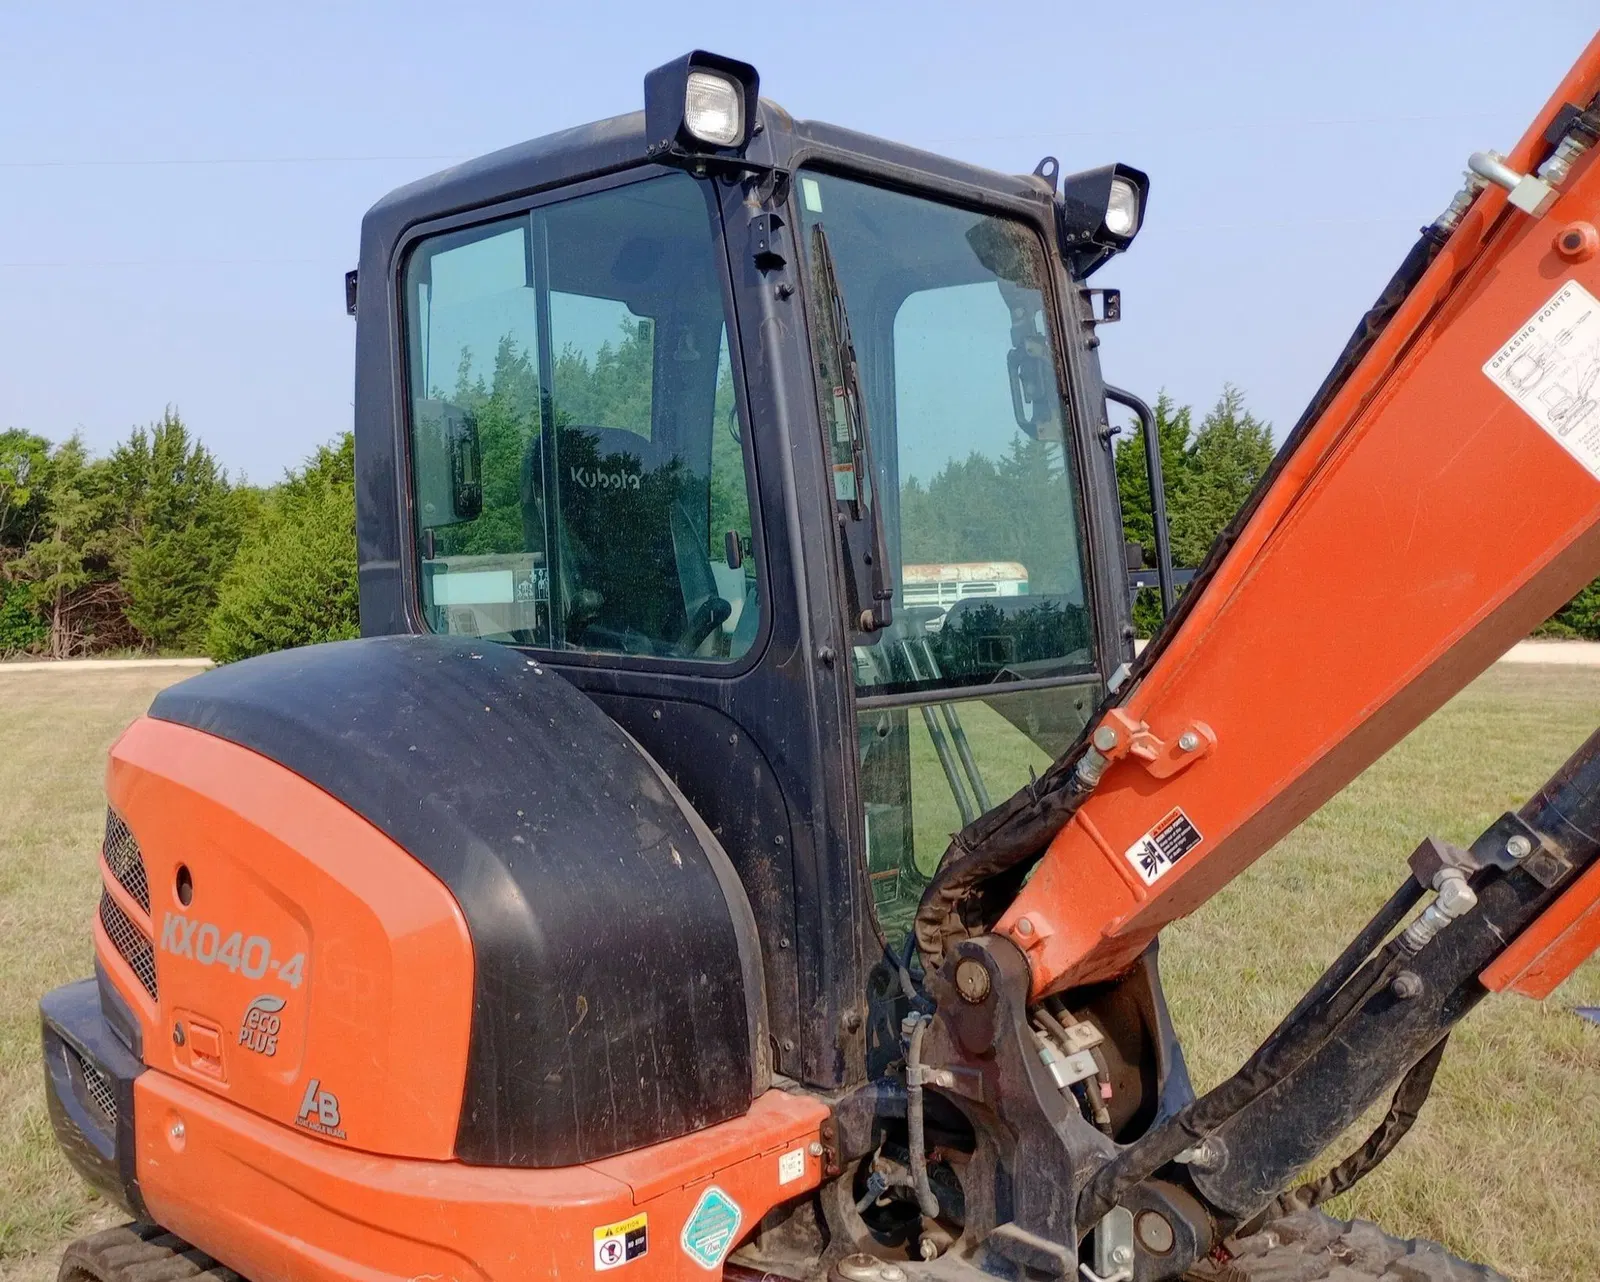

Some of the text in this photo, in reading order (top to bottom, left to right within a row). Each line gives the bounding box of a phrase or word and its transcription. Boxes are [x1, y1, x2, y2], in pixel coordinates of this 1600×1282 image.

[1492, 290, 1572, 369] GREASING POINTS
[570, 466, 641, 490] Kubota
[161, 912, 305, 989] KX040-4
[239, 1026, 279, 1057] PLUS
[616, 1220, 639, 1232] CAUTION
